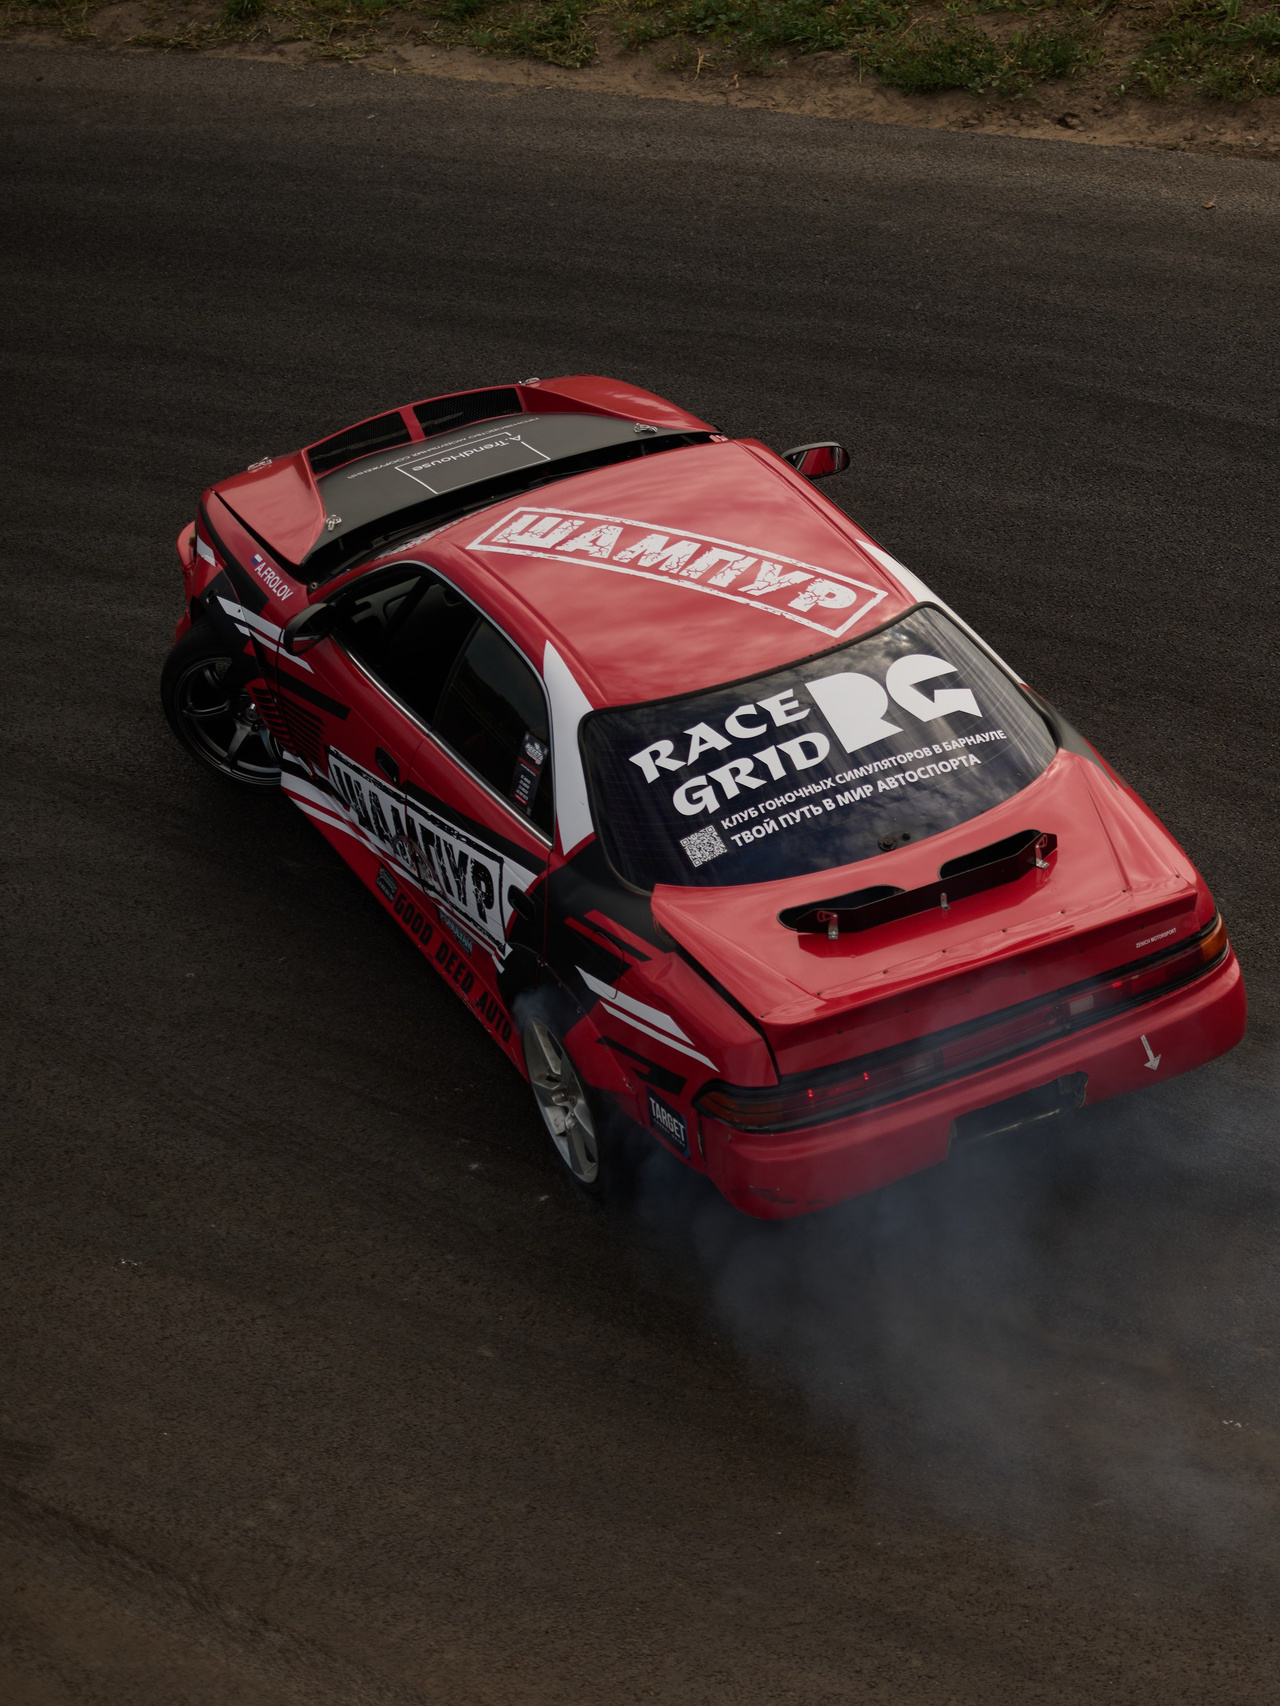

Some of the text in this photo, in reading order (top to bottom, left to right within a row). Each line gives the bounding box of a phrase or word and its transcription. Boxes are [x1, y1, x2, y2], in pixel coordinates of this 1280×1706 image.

[412, 434, 521, 472] A.TrendHouse
[254, 562, 293, 601] A.FROLOV
[491, 514, 857, 612] ШАМПУР
[628, 689, 811, 784] RACE
[672, 732, 831, 816] GRID
[721, 729, 1007, 830] КЛУБ ГОНОЧНЫХ СИМУЛЯТОРОВ В БАРНАУЛЕ
[333, 764, 494, 923] ШАМПУР
[730, 753, 982, 848] ТВОЙ ПУТЬ В МИР АВТОСПОРТА
[393, 893, 432, 946] GOOD
[436, 941, 474, 994] DEED
[475, 992, 512, 1043] AUTO
[649, 1096, 685, 1142] TARGET
